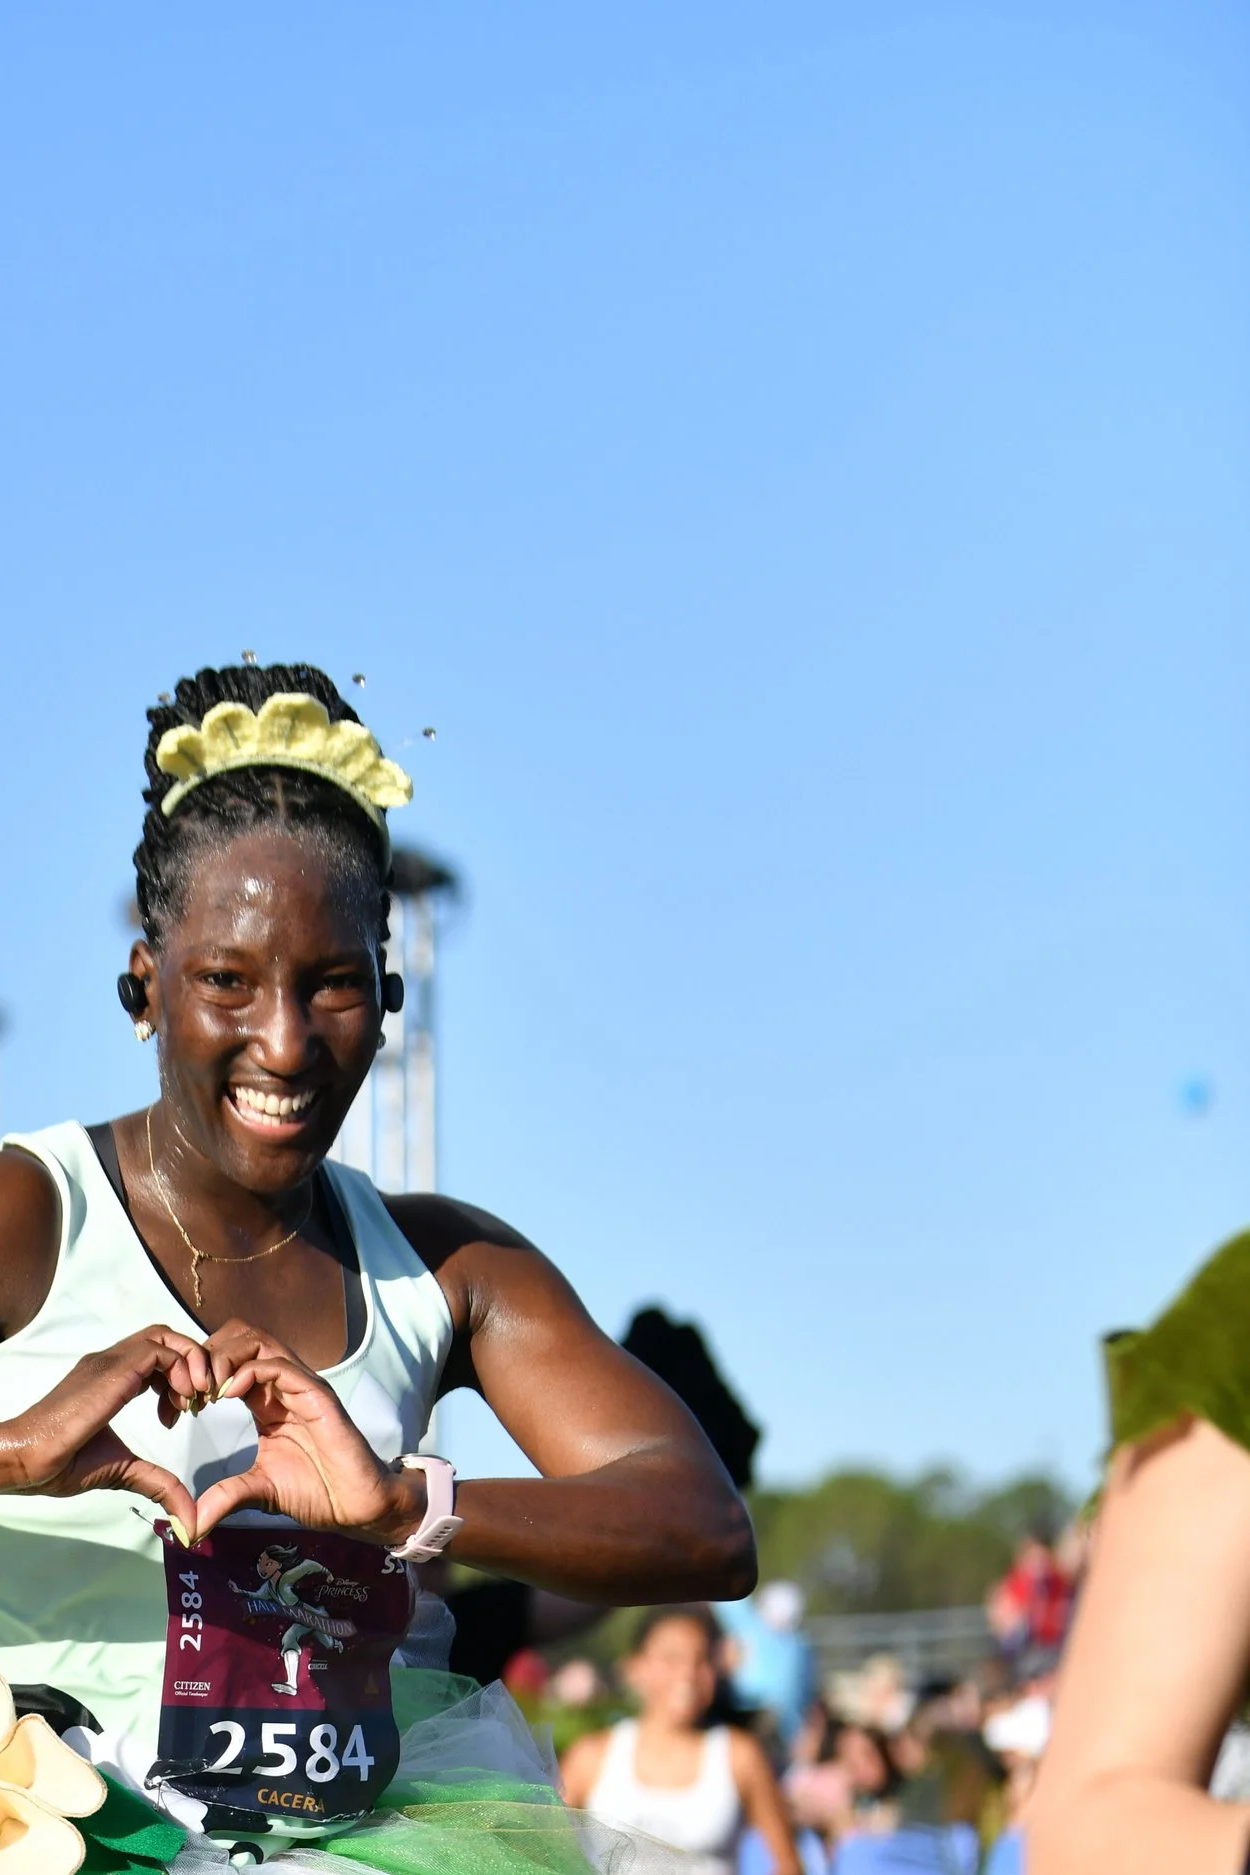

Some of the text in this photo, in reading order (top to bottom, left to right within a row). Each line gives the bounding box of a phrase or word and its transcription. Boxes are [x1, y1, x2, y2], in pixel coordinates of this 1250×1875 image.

[315, 1585, 371, 1602] PRINCESS
[179, 1570, 203, 1652] 2584
[282, 1606, 354, 1635] MARATHON
[174, 1681, 211, 1691] CITIZEN
[209, 1721, 375, 1783] 2584
[257, 1788, 326, 1813] CACERA
